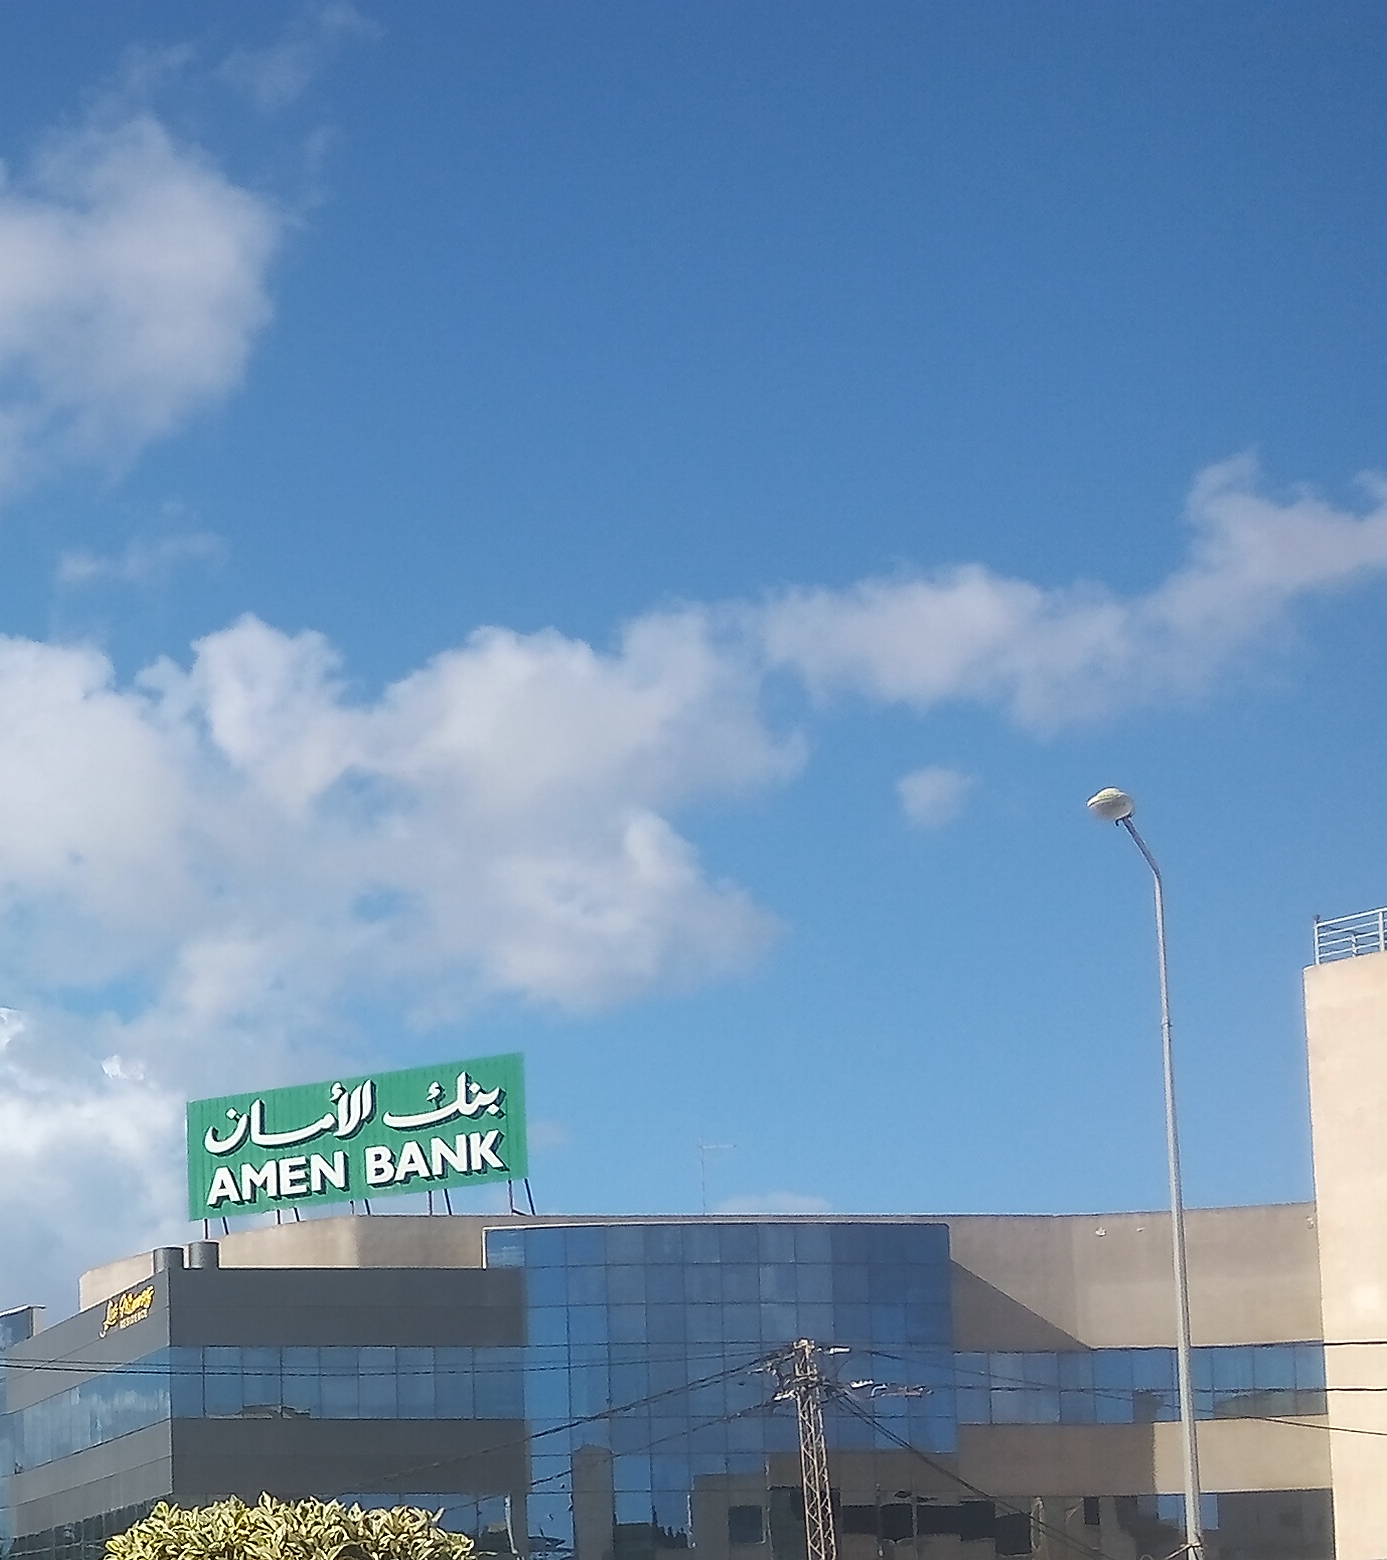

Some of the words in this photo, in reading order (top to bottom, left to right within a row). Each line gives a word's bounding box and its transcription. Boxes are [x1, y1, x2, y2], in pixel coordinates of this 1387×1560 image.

[382, 1070, 505, 1130] بنك
[206, 1149, 348, 1207] AMEN
[365, 1129, 509, 1187] BANK
